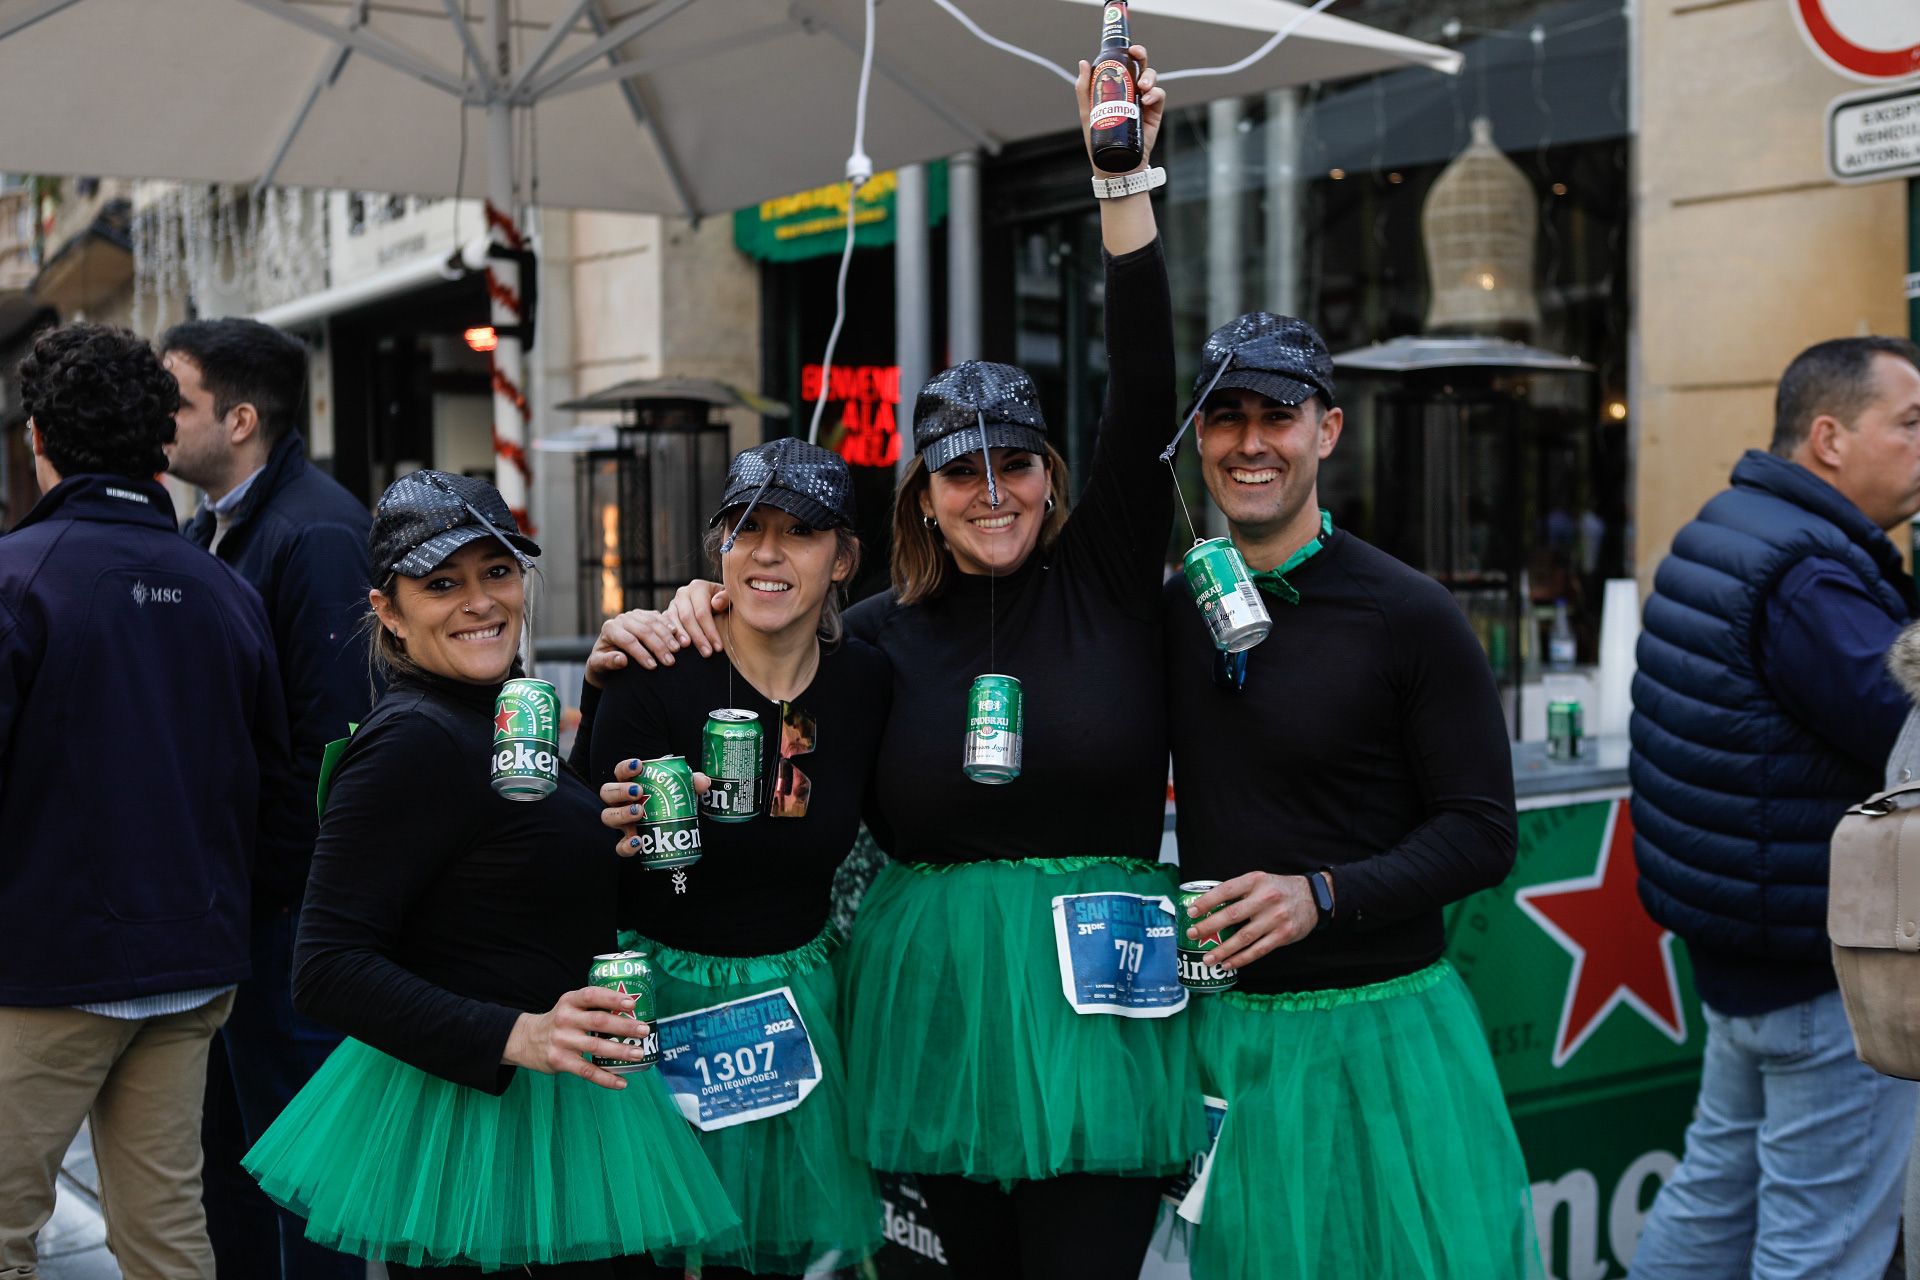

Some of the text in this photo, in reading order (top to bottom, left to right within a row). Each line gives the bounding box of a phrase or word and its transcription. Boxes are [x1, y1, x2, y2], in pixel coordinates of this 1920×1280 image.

[151, 587, 182, 604] MSC
[506, 683, 553, 731] ORIGINAL
[1075, 900, 1109, 923] SAN
[1145, 926, 1175, 938] 2022
[659, 1021, 694, 1048] SAN
[694, 998, 792, 1037] SILVESTRE
[763, 1018, 796, 1036] 2022
[694, 1040, 776, 1087] 1307
[701, 1083, 724, 1097] DORI
